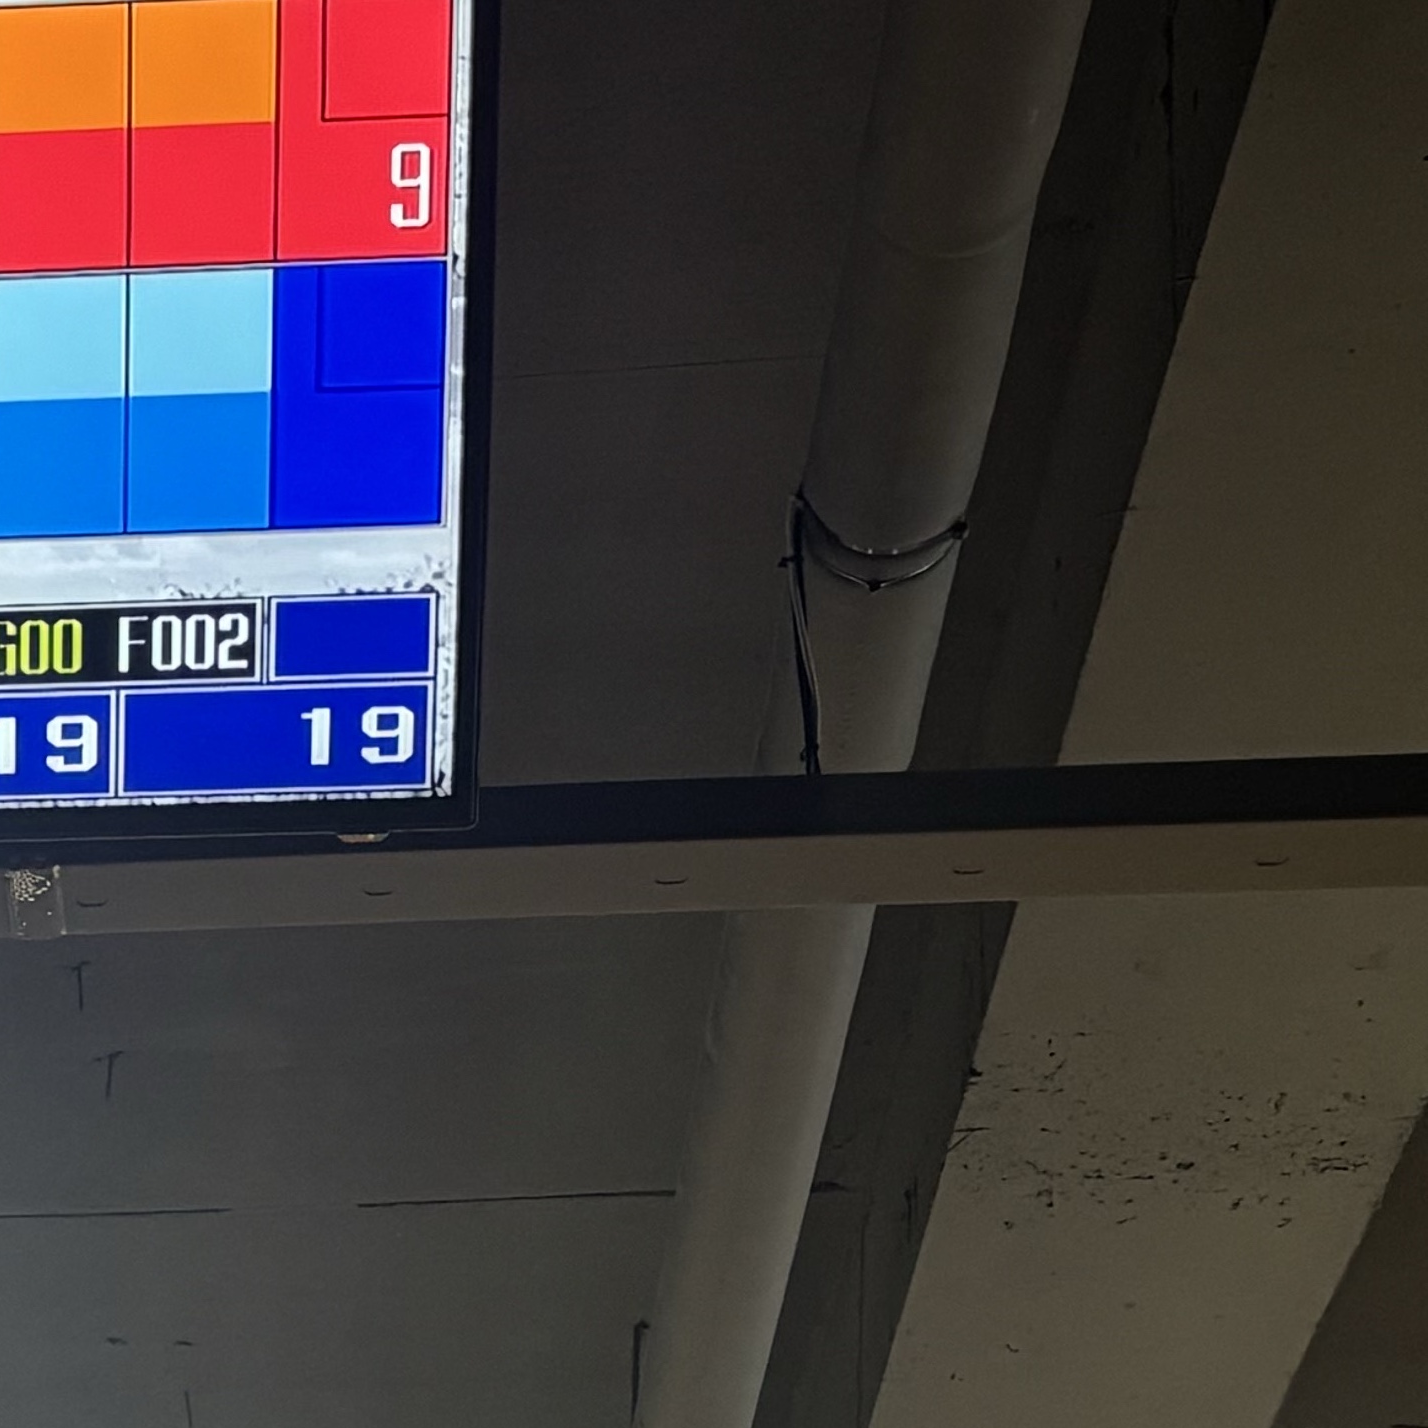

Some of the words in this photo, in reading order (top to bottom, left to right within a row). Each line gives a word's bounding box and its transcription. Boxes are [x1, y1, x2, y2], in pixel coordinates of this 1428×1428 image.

[389, 141, 433, 229] 9
[117, 613, 250, 674] F002
[300, 705, 416, 766] 19
